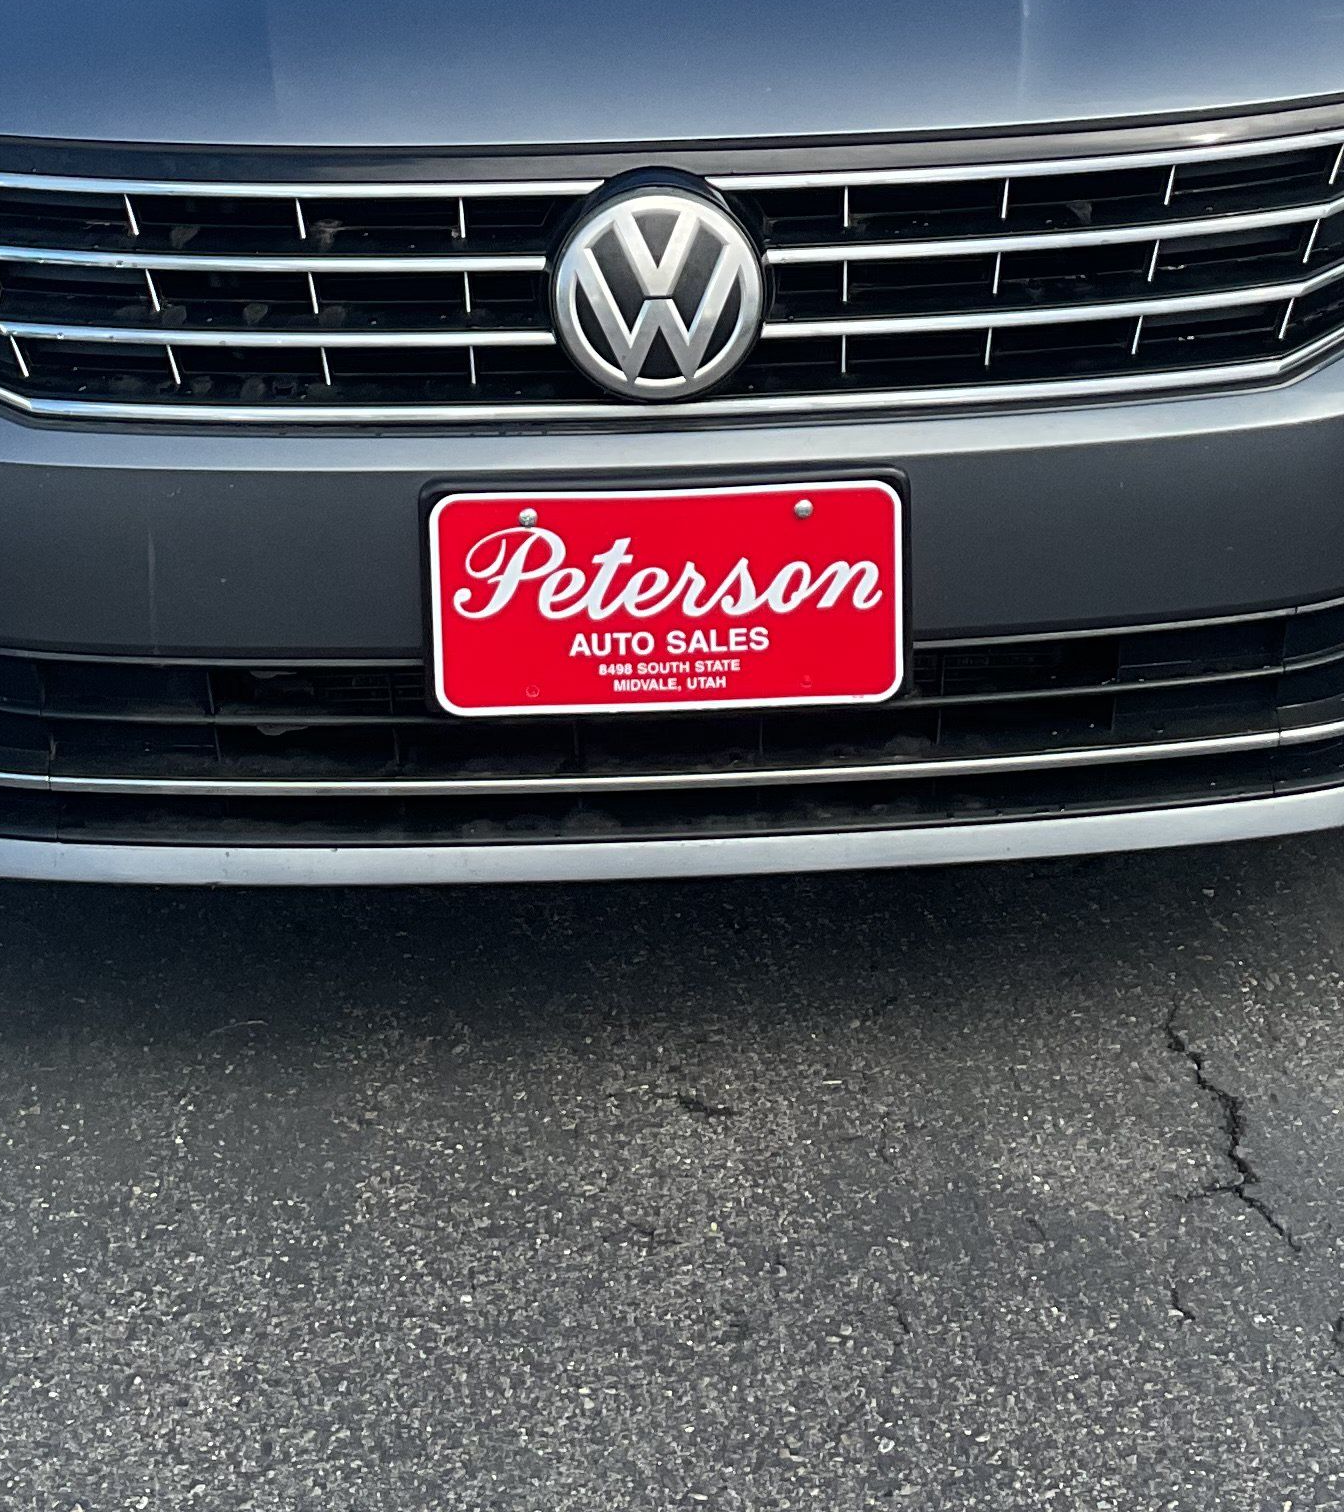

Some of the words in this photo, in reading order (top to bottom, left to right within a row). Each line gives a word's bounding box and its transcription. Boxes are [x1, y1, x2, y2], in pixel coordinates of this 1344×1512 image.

[453, 525, 884, 621] Peterson
[569, 631, 655, 657] AUTO
[666, 626, 770, 654] SALES
[598, 663, 633, 676] 8498
[637, 661, 691, 675] SOUTH
[694, 659, 741, 673] STATE
[613, 677, 682, 692] MIDVALE,
[686, 676, 727, 690] UTAH
